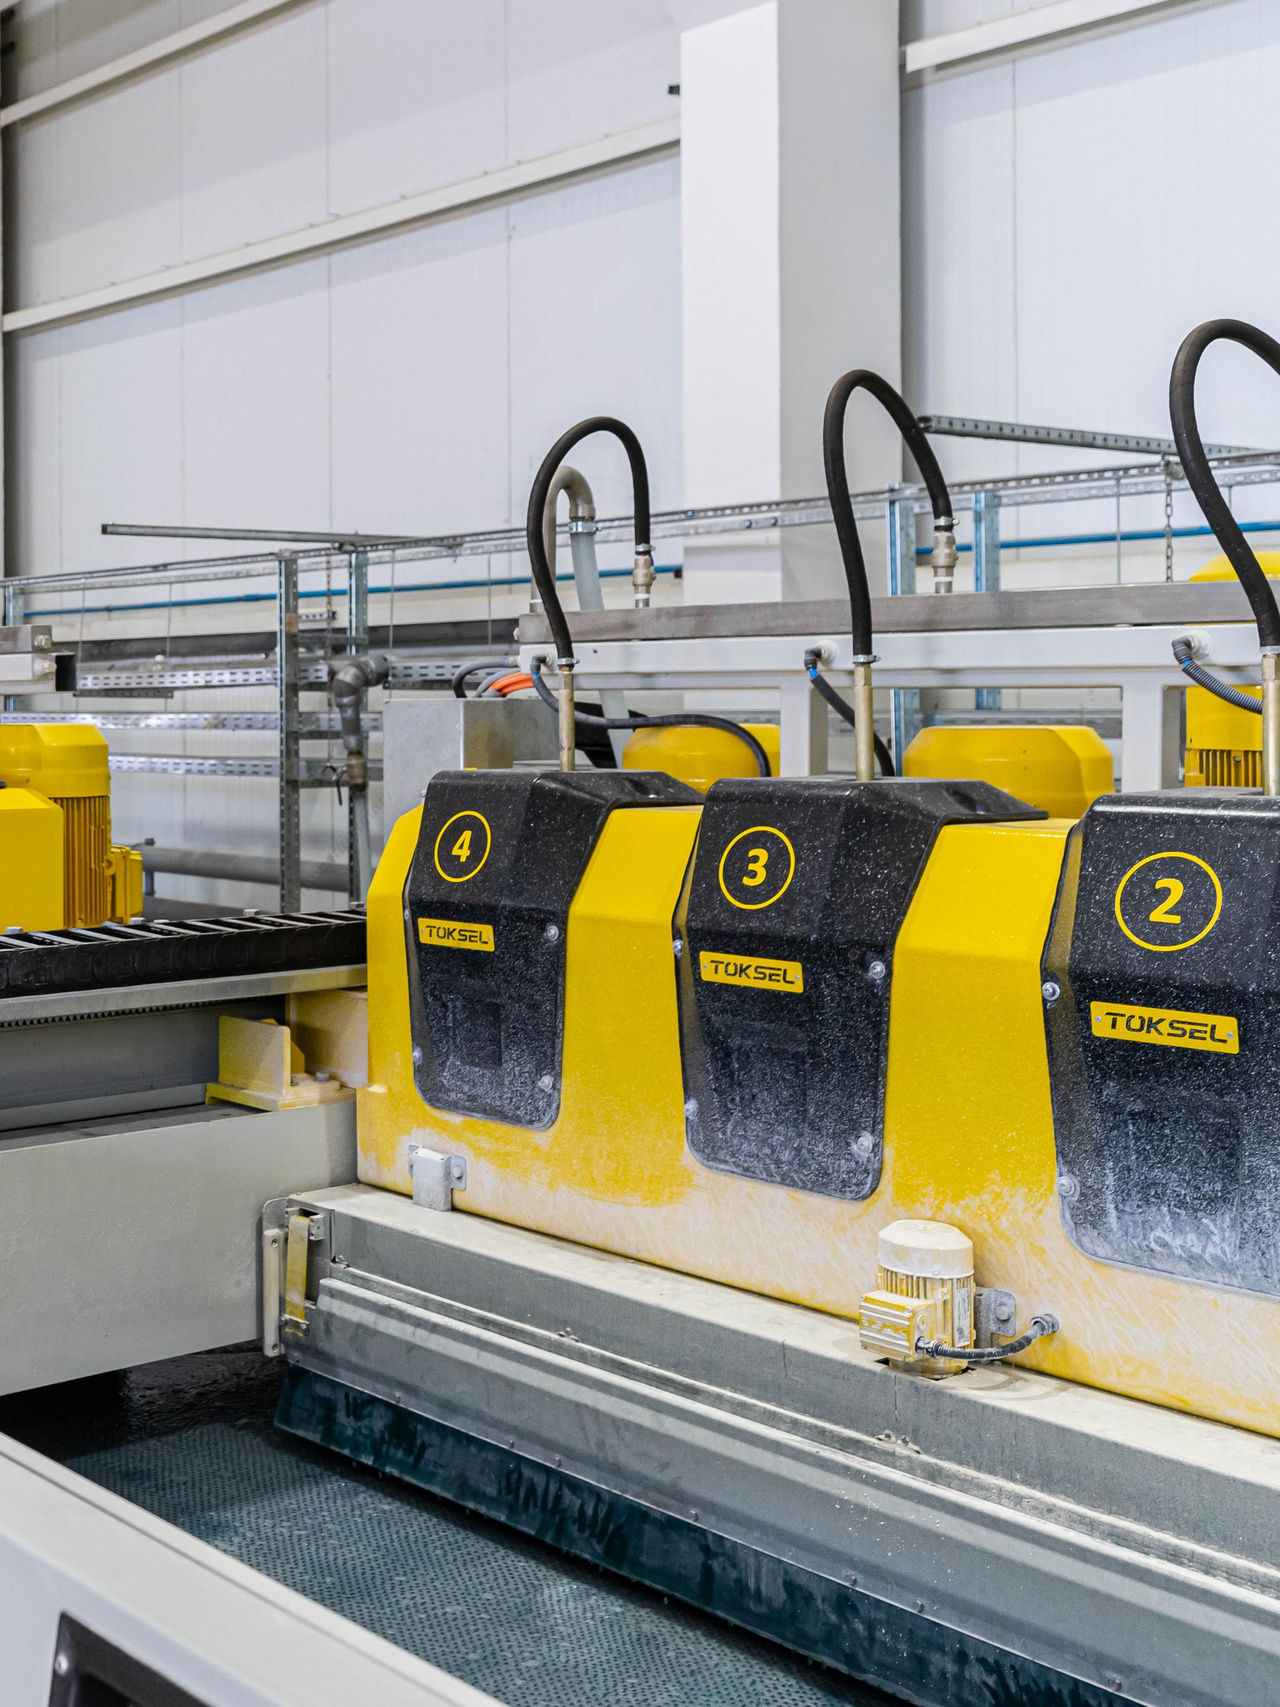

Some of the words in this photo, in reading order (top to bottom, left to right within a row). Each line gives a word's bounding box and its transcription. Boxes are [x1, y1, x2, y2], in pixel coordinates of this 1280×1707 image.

[451, 830, 473, 863] 4
[741, 847, 769, 887] 3
[1148, 877, 1185, 924] 2
